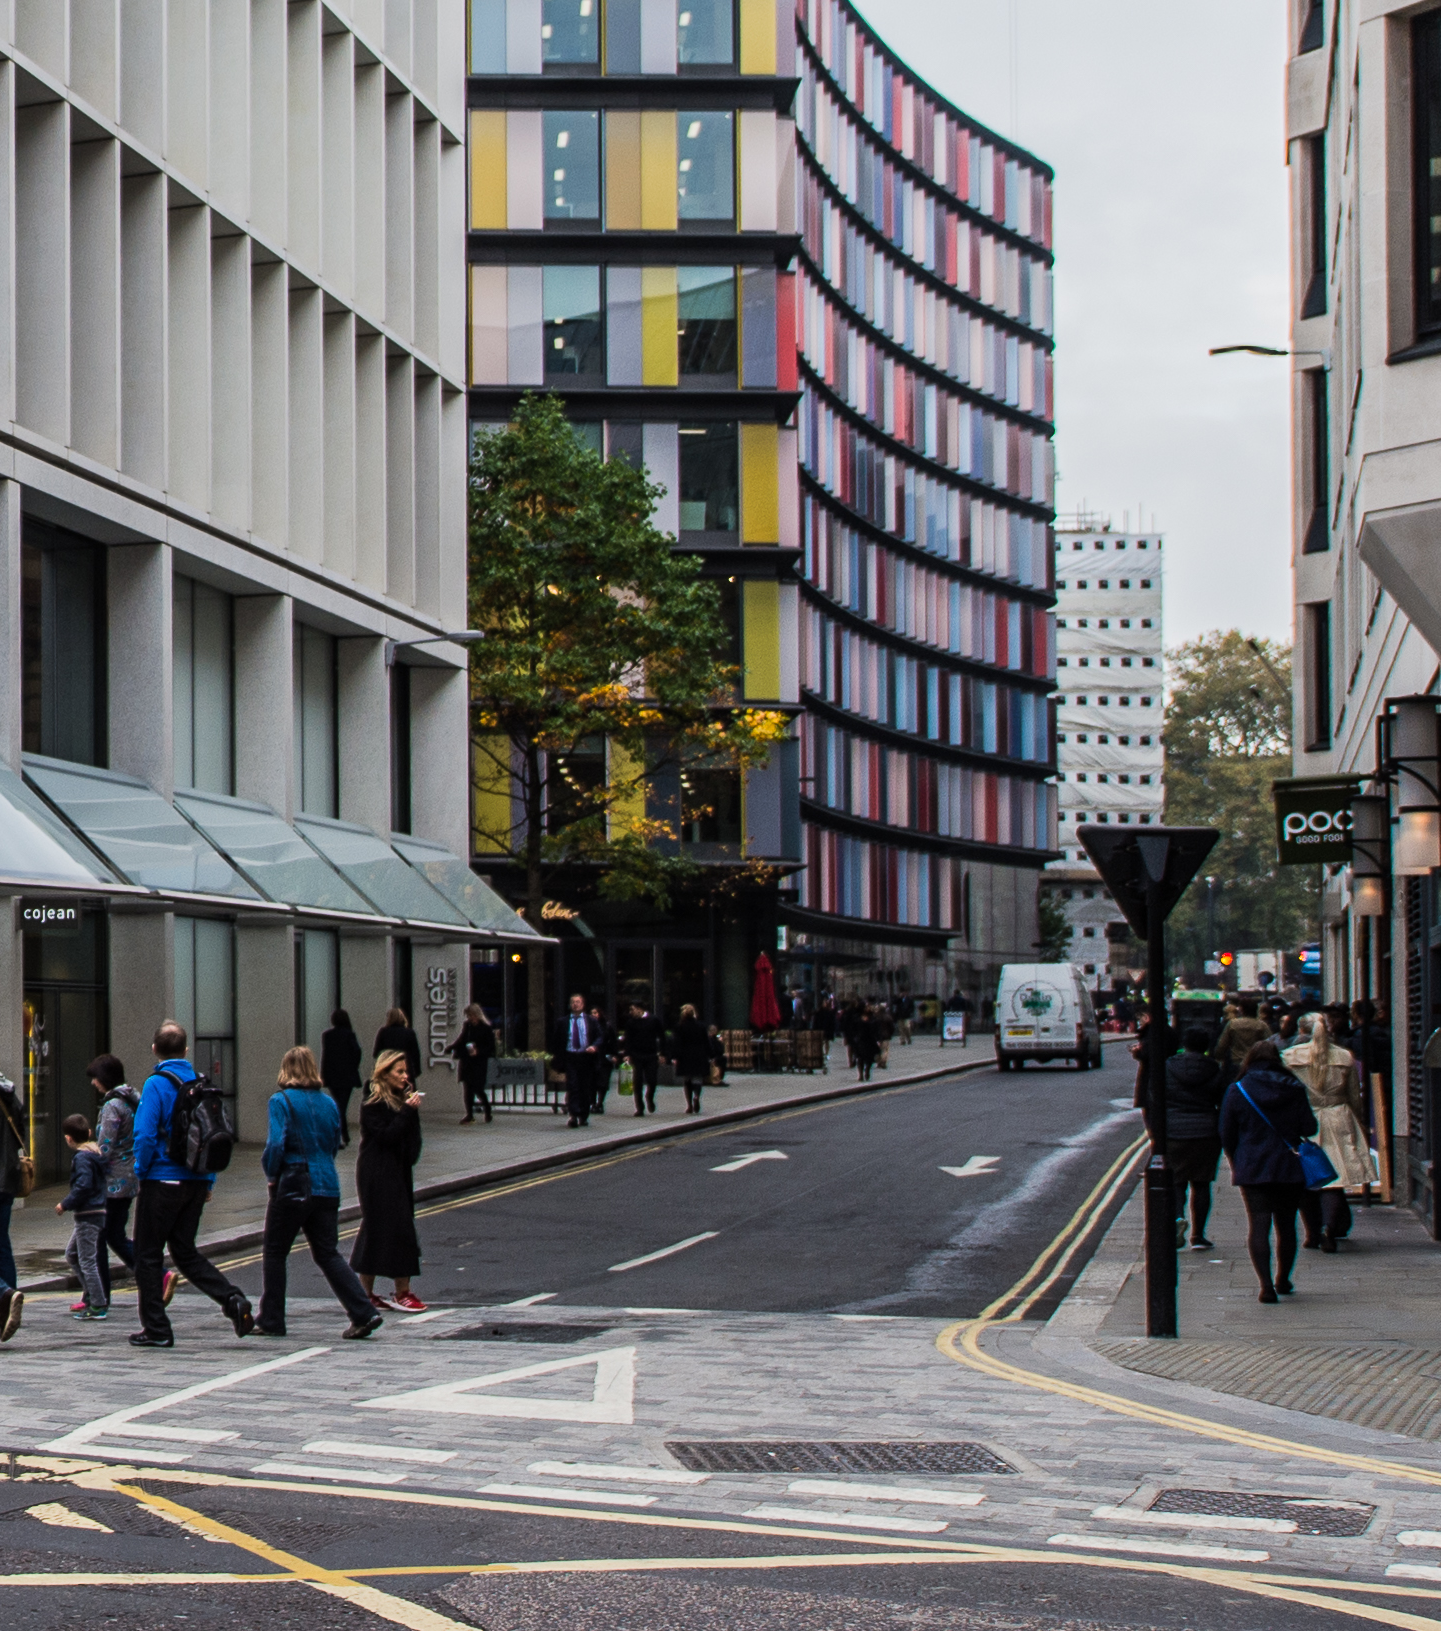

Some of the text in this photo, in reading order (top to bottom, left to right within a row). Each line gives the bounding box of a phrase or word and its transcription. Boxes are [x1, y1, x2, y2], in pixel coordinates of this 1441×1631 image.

[1295, 834, 1320, 844] GOOD
[23, 905, 75, 923] cojean
[425, 967, 456, 1070] Jamie's
